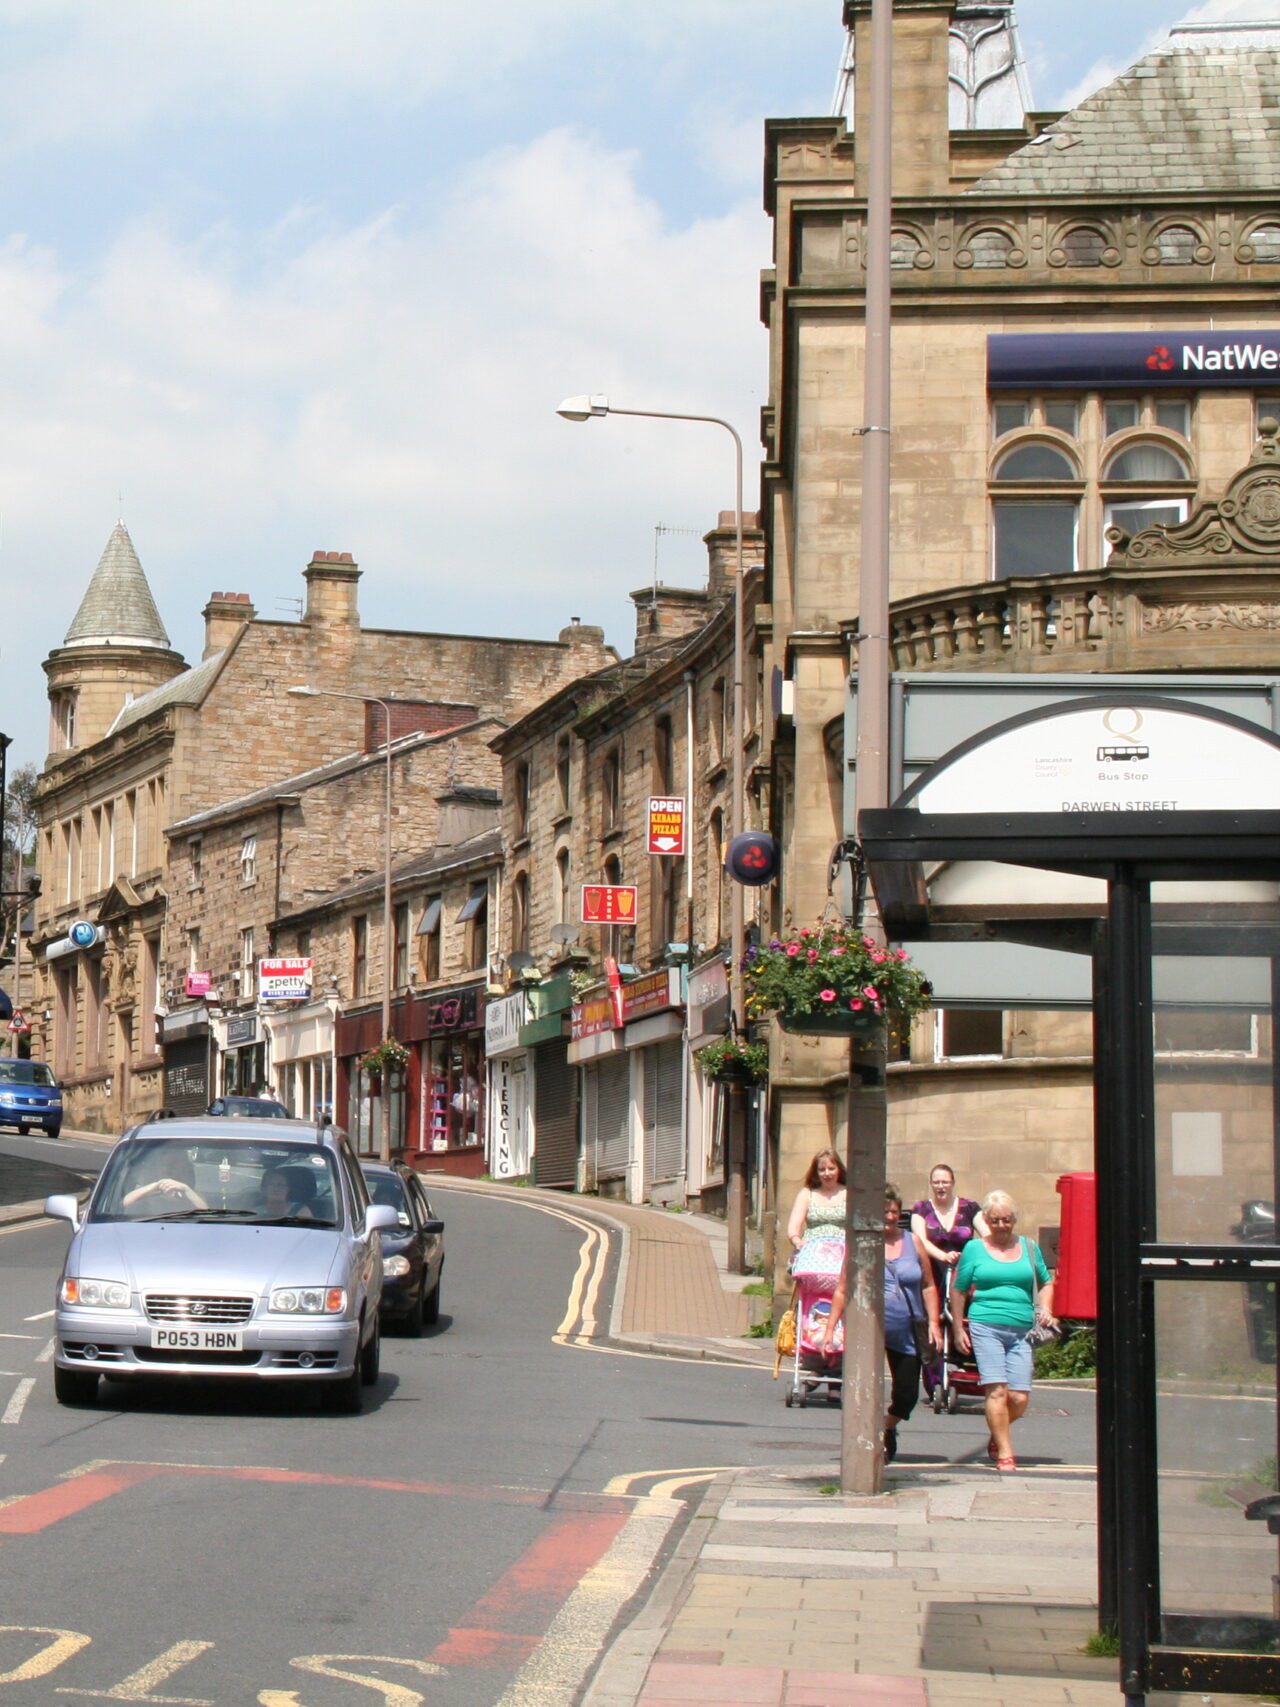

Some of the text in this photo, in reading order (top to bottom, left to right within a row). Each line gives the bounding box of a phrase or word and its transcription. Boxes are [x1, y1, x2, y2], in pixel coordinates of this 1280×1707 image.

[1035, 756, 1073, 764] Lancashire
[1098, 771, 1149, 782] Bus Stop
[650, 800, 682, 812] OPEN
[1061, 800, 1178, 812] DARWEN STREET
[650, 813, 682, 824] KEBABS
[652, 824, 680, 835] PIZZAS
[263, 960, 309, 969] FOR SALE
[275, 976, 305, 989] petty
[500, 1061, 509, 1174] PIERCING
[157, 1330, 237, 1348] PO53 HBN
